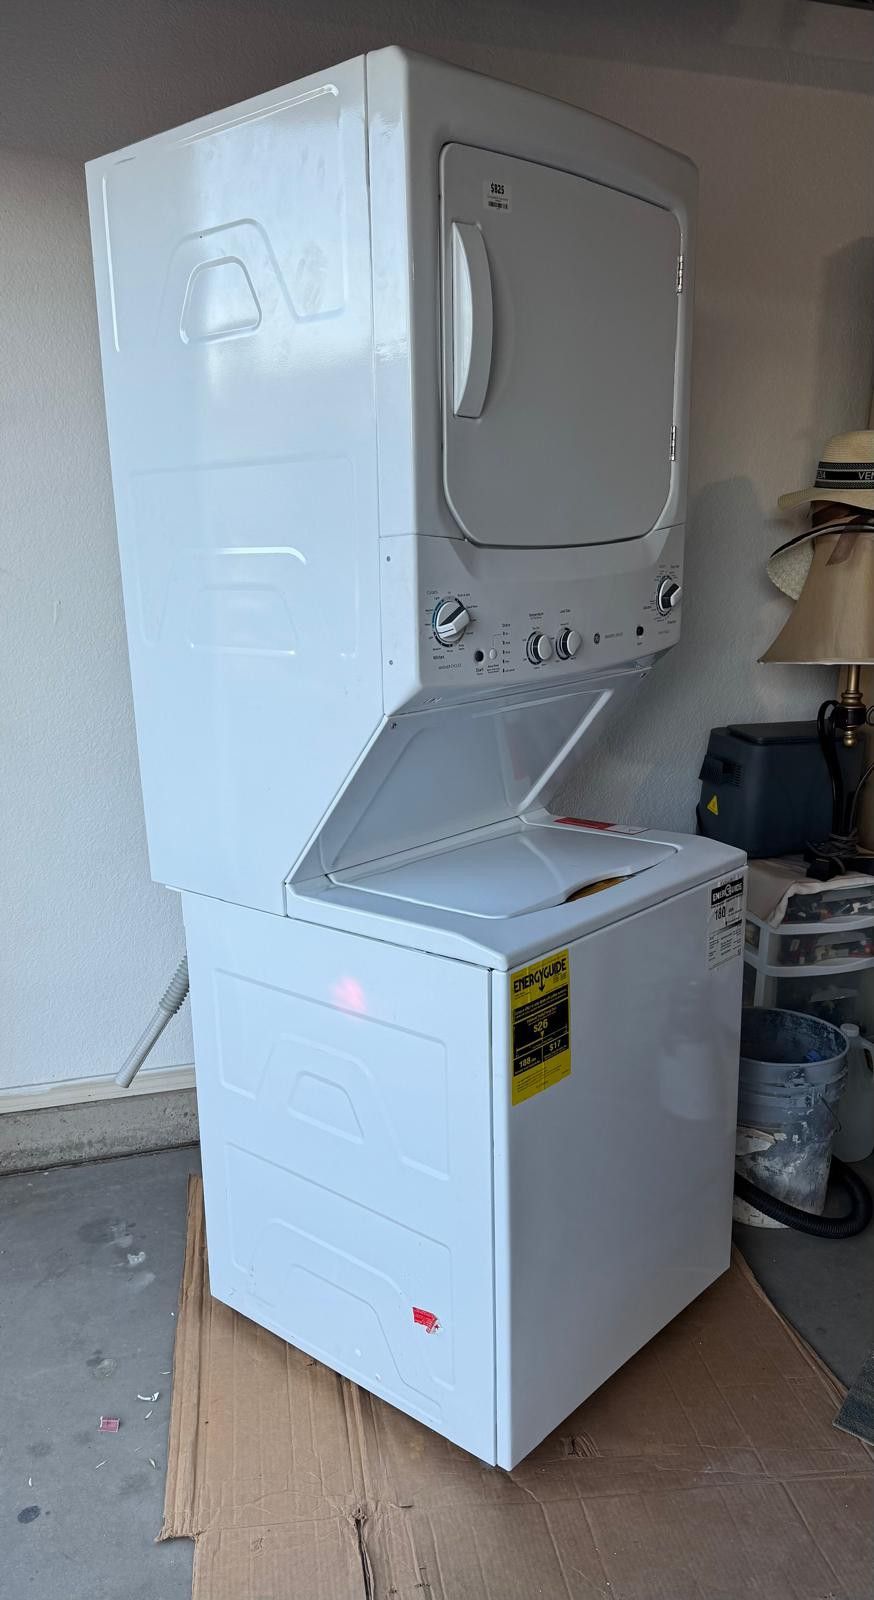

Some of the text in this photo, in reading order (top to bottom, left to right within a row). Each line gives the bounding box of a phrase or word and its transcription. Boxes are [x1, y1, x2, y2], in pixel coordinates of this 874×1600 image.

[490, 181, 505, 195] $825
[712, 882, 743, 902] ENERGUIDE
[513, 958, 567, 993] ENERGYGUIDE
[533, 1018, 549, 1033] $26
[549, 1039, 561, 1052] $17
